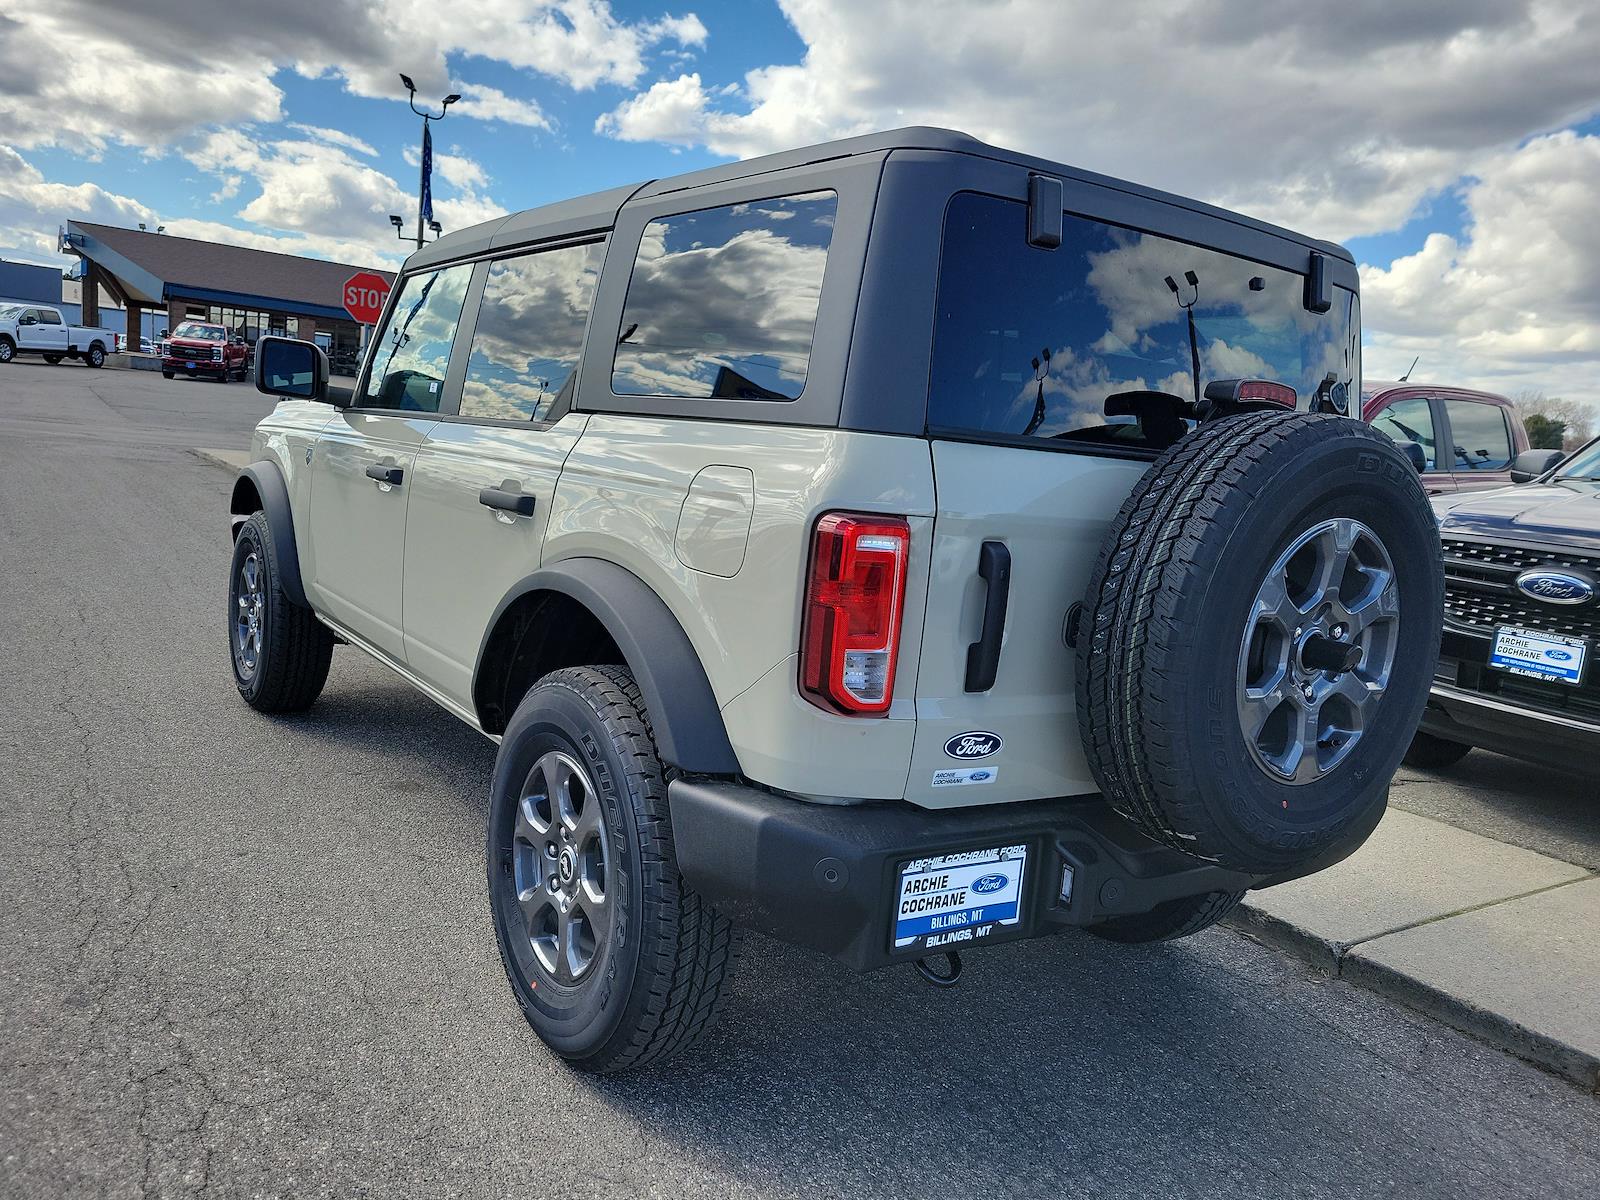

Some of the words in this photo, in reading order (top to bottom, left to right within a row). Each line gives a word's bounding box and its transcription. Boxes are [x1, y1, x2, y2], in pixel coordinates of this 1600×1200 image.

[1533, 578, 1576, 598] Ford
[1499, 636, 1530, 648] ARCHIE
[1500, 626, 1525, 635] ARCHIE
[1525, 630, 1564, 642] COCHRANE
[1564, 637, 1585, 645] FORD
[1497, 645, 1542, 660] COCHRANE
[1544, 672, 1557, 682] MT
[956, 736, 994, 755] Ford
[907, 855, 944, 871] ARCHIE
[945, 849, 999, 864] COCHRANE
[999, 845, 1027, 857] FORD
[904, 874, 949, 895] ARCHIE
[977, 876, 1003, 892] Ford
[901, 891, 967, 915] COCHRANE
[930, 911, 970, 930] BILLINGS,
[971, 908, 984, 922] MT
[925, 929, 973, 948] BILLINGS,
[976, 925, 993, 938] MT
